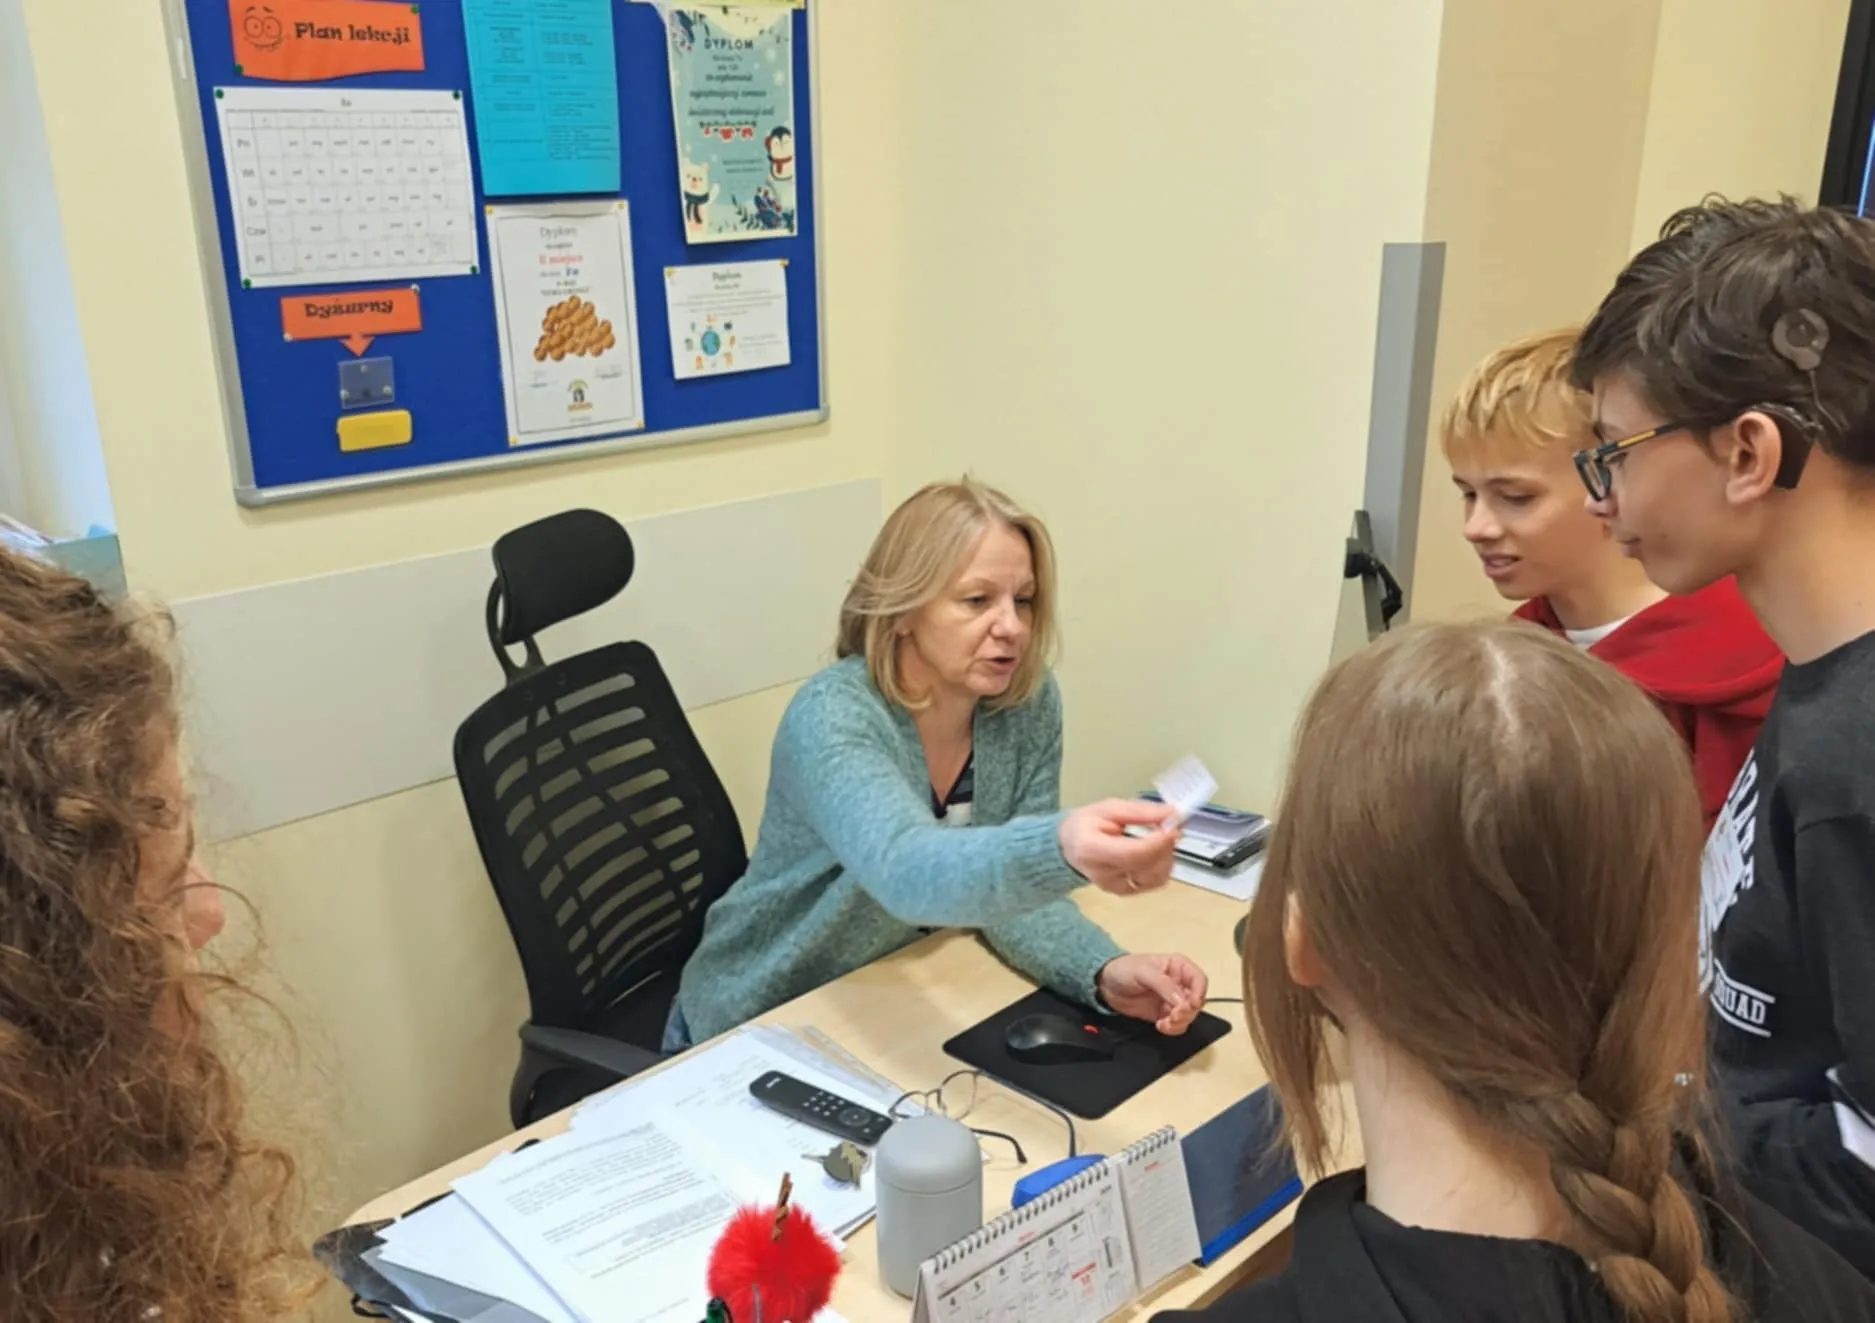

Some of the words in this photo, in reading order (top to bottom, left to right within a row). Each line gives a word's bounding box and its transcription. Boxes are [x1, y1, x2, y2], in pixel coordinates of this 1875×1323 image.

[294, 21, 342, 41] Plan
[348, 23, 411, 46] lekcji
[704, 38, 753, 50] DYPLOM
[304, 298, 394, 319] Dyżurny
